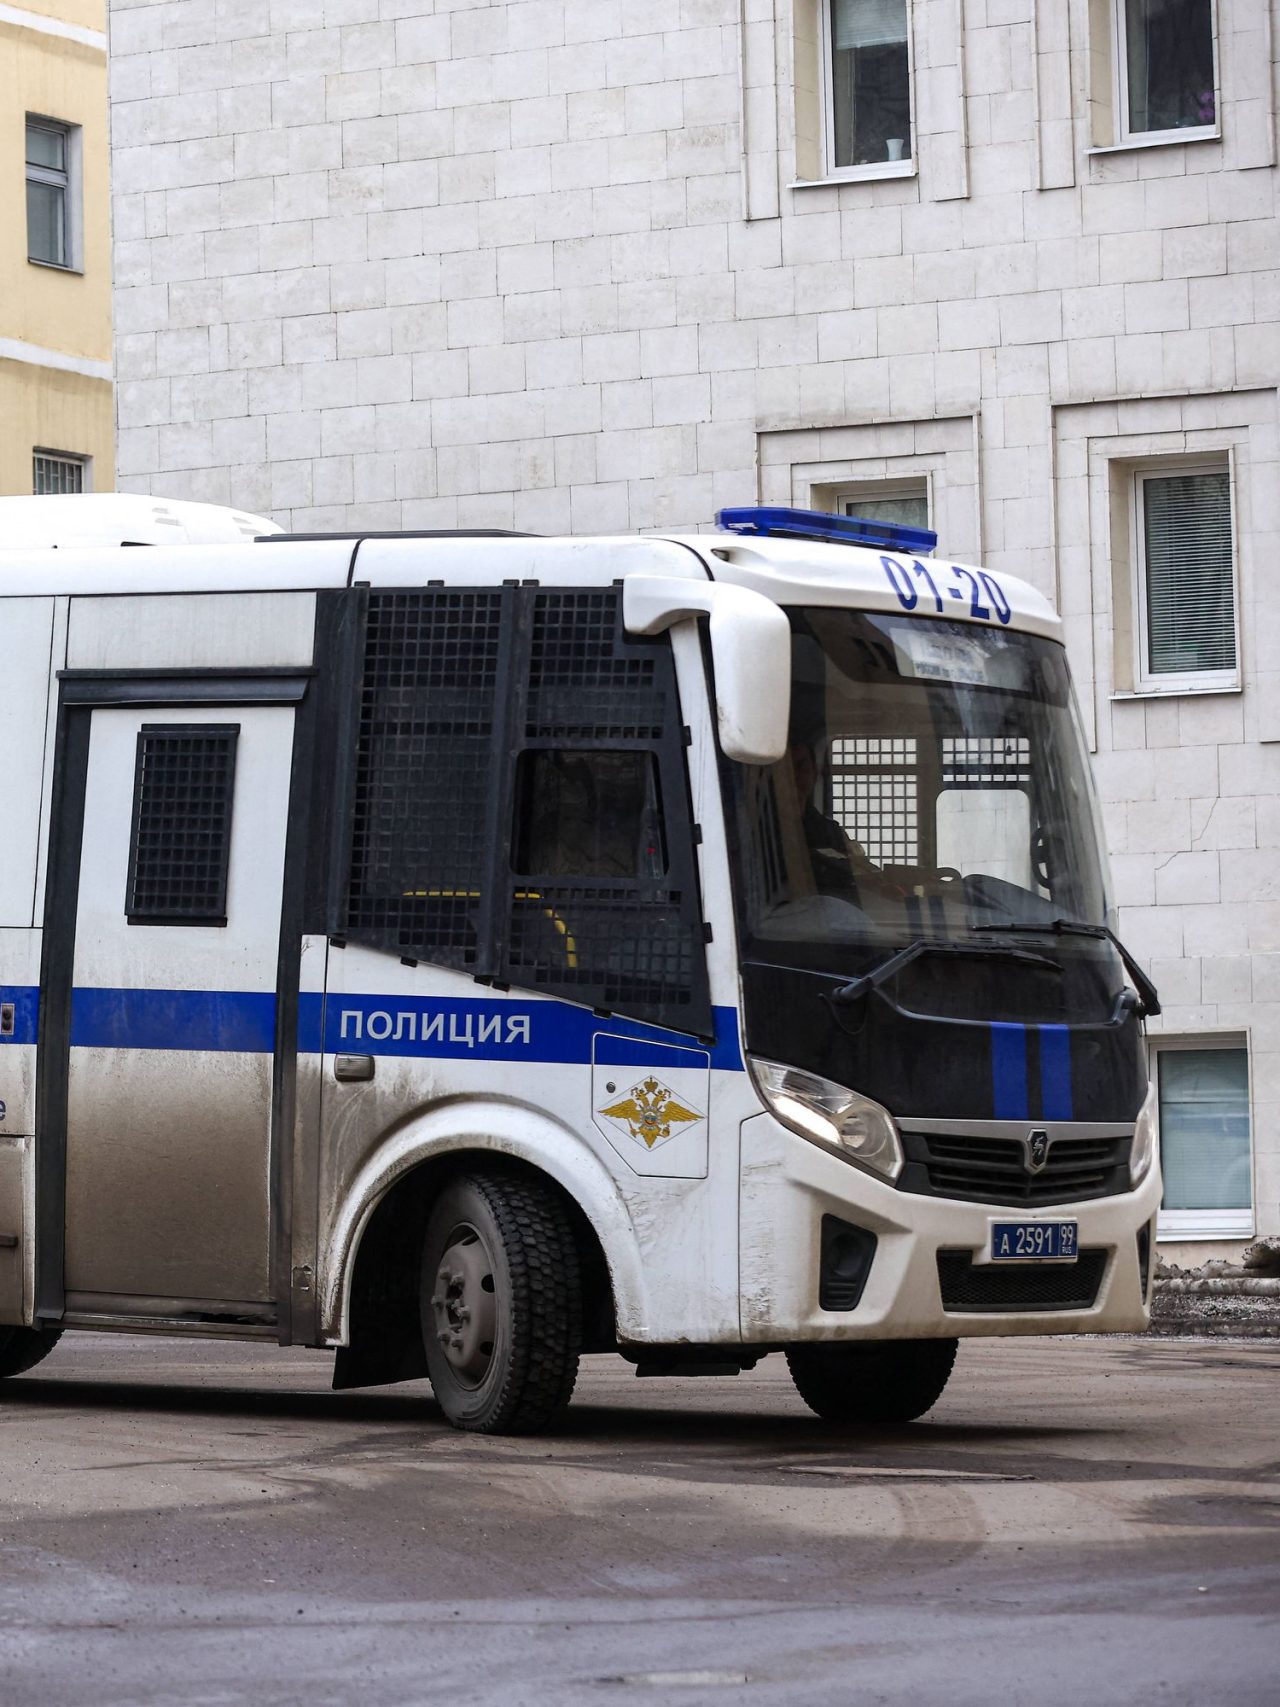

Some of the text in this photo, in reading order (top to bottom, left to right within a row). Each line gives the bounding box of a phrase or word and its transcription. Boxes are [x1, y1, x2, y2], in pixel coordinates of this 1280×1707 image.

[879, 556, 1011, 624] 01-20
[340, 1010, 530, 1048] ПОЛИЦИЯ
[1016, 1227, 1052, 1254] 2591
[1060, 1225, 1074, 1246] 99
[1061, 1246, 1072, 1254] RUS
